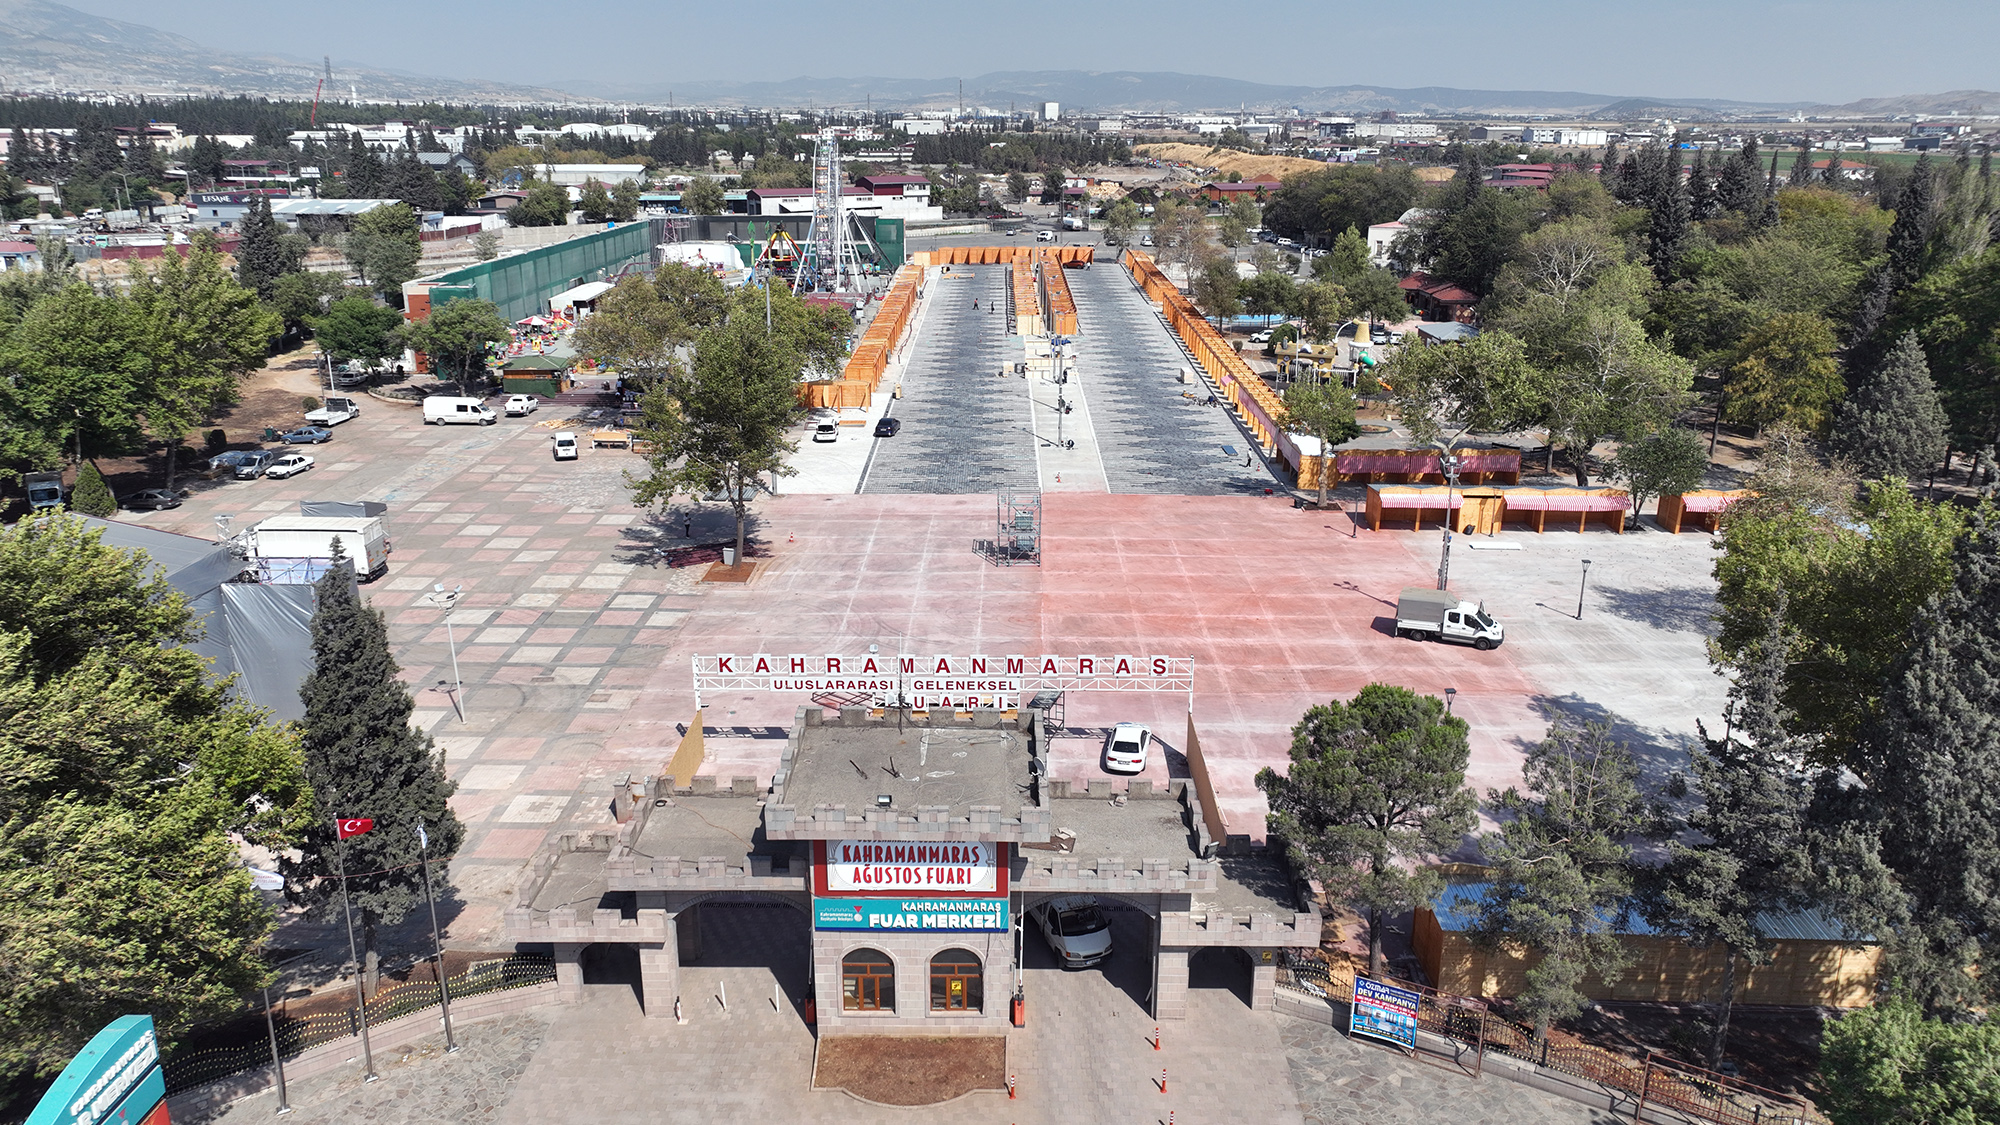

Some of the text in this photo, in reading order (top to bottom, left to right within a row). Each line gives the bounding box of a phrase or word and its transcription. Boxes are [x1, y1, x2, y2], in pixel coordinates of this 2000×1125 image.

[773, 680, 1018, 691] ULUSLARARASI GELENEKSEL
[843, 845, 980, 867] KAHRAMANMARAŞ
[853, 864, 971, 884] AĞUSTOS FUARI
[901, 902, 1001, 915] KAHRAMANMARAŞ
[869, 910, 1001, 929] FUAR MERKEZİ
[1357, 987, 1373, 997] DEV
[1374, 991, 1417, 1011] KAMPANYA
